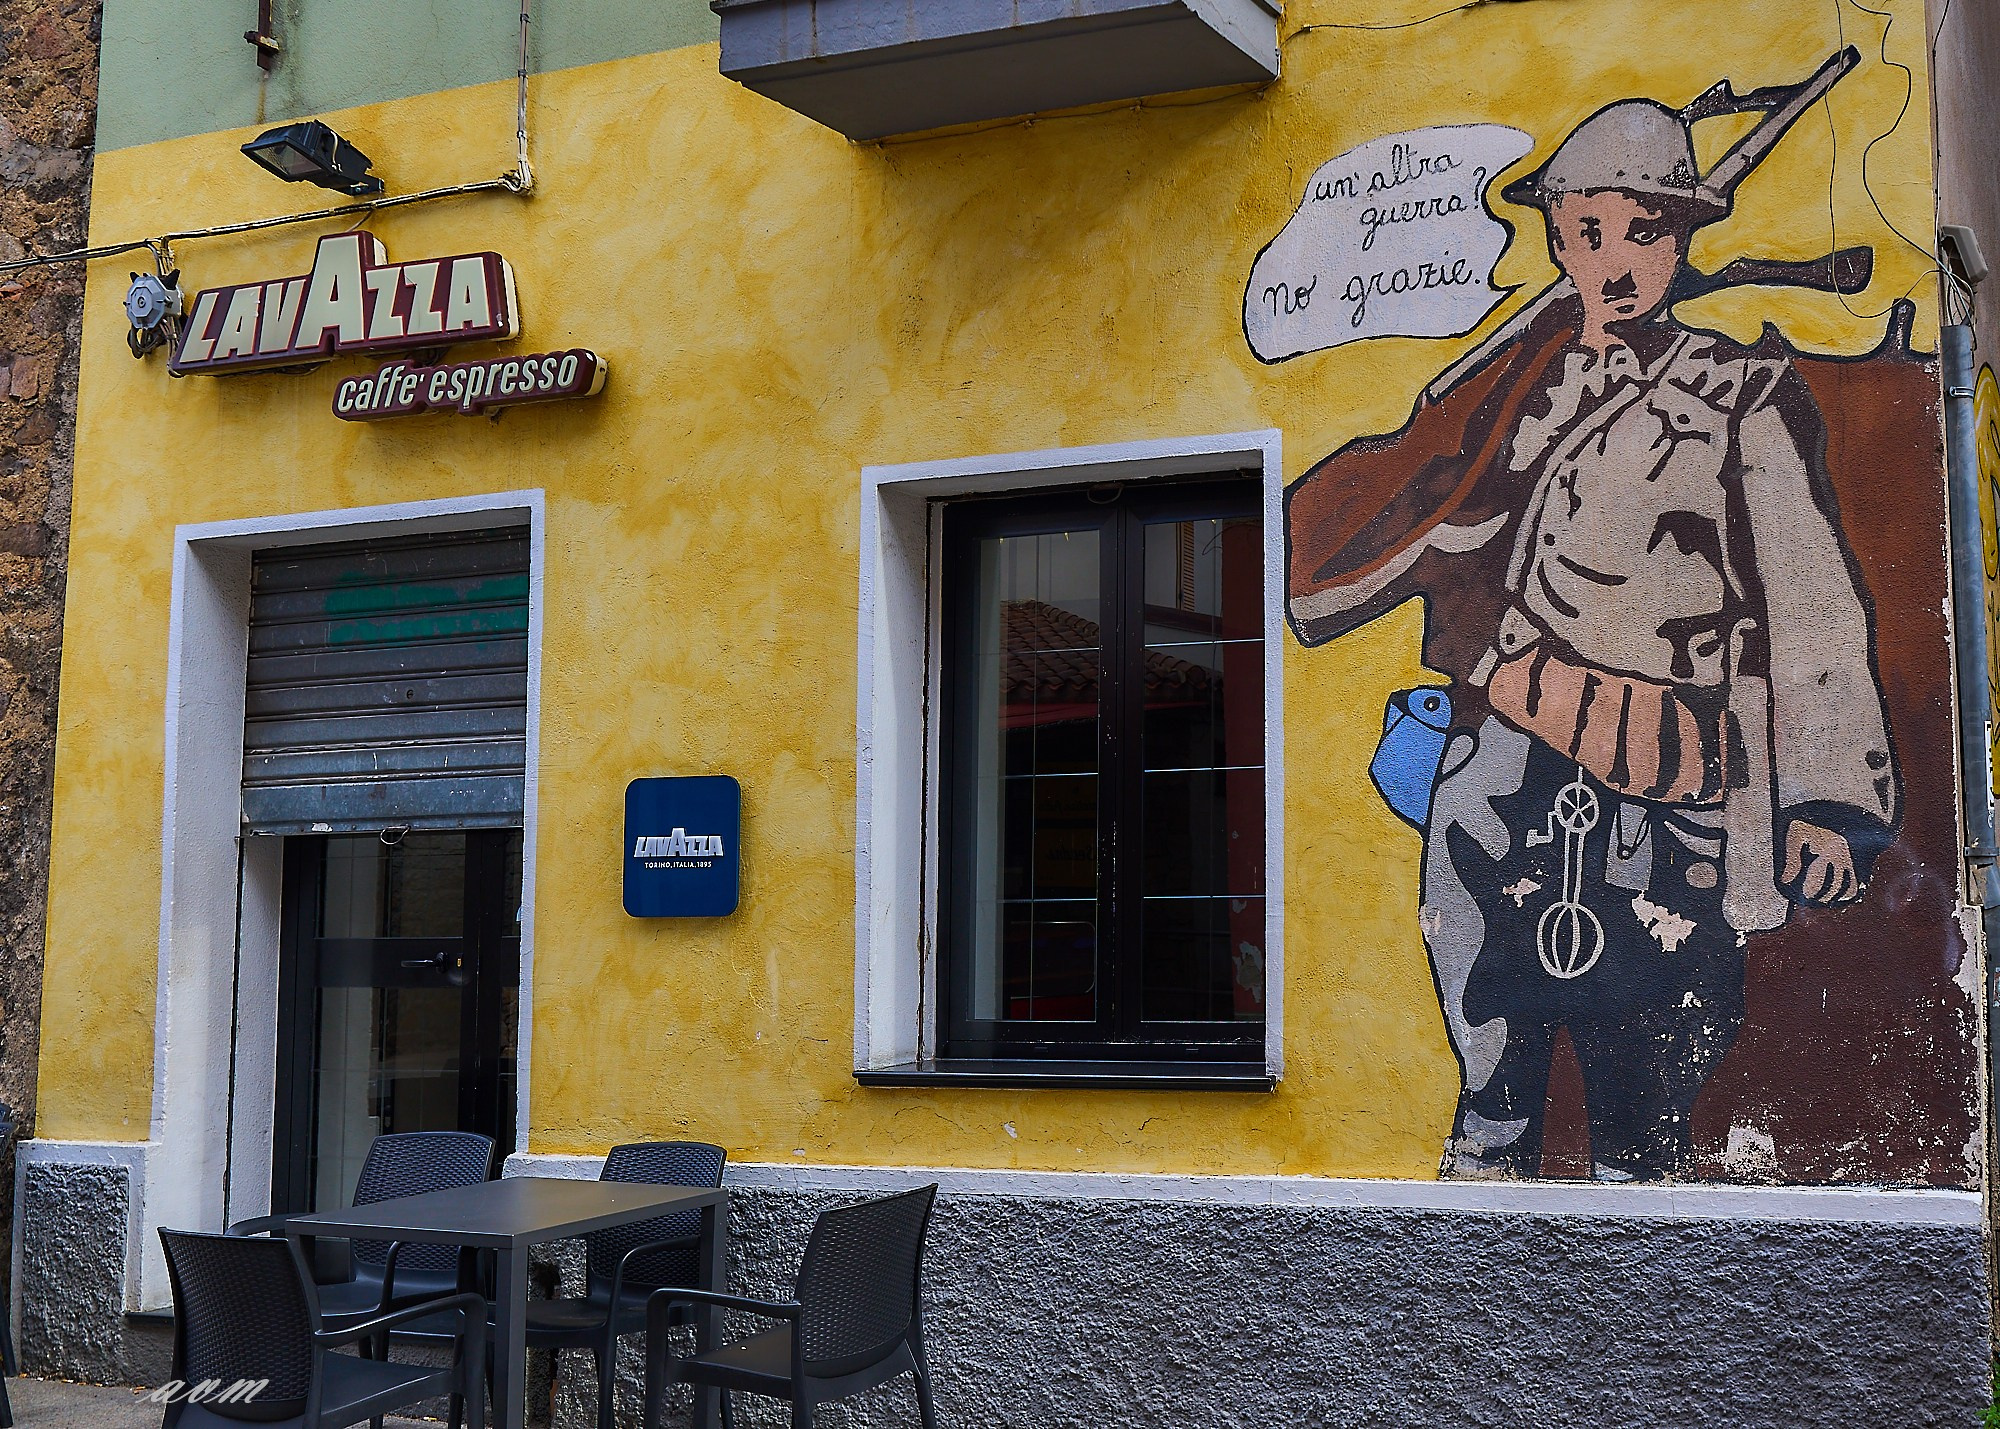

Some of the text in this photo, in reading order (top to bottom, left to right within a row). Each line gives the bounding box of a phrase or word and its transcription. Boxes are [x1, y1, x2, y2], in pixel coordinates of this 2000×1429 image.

[1312, 144, 1463, 202] un'altra
[1359, 166, 1487, 251] guerra?
[179, 233, 491, 363] LAVAZZA
[1340, 251, 1480, 328] grazie.
[429, 353, 579, 410] espresso
[633, 827, 724, 858] LAVAZZA
